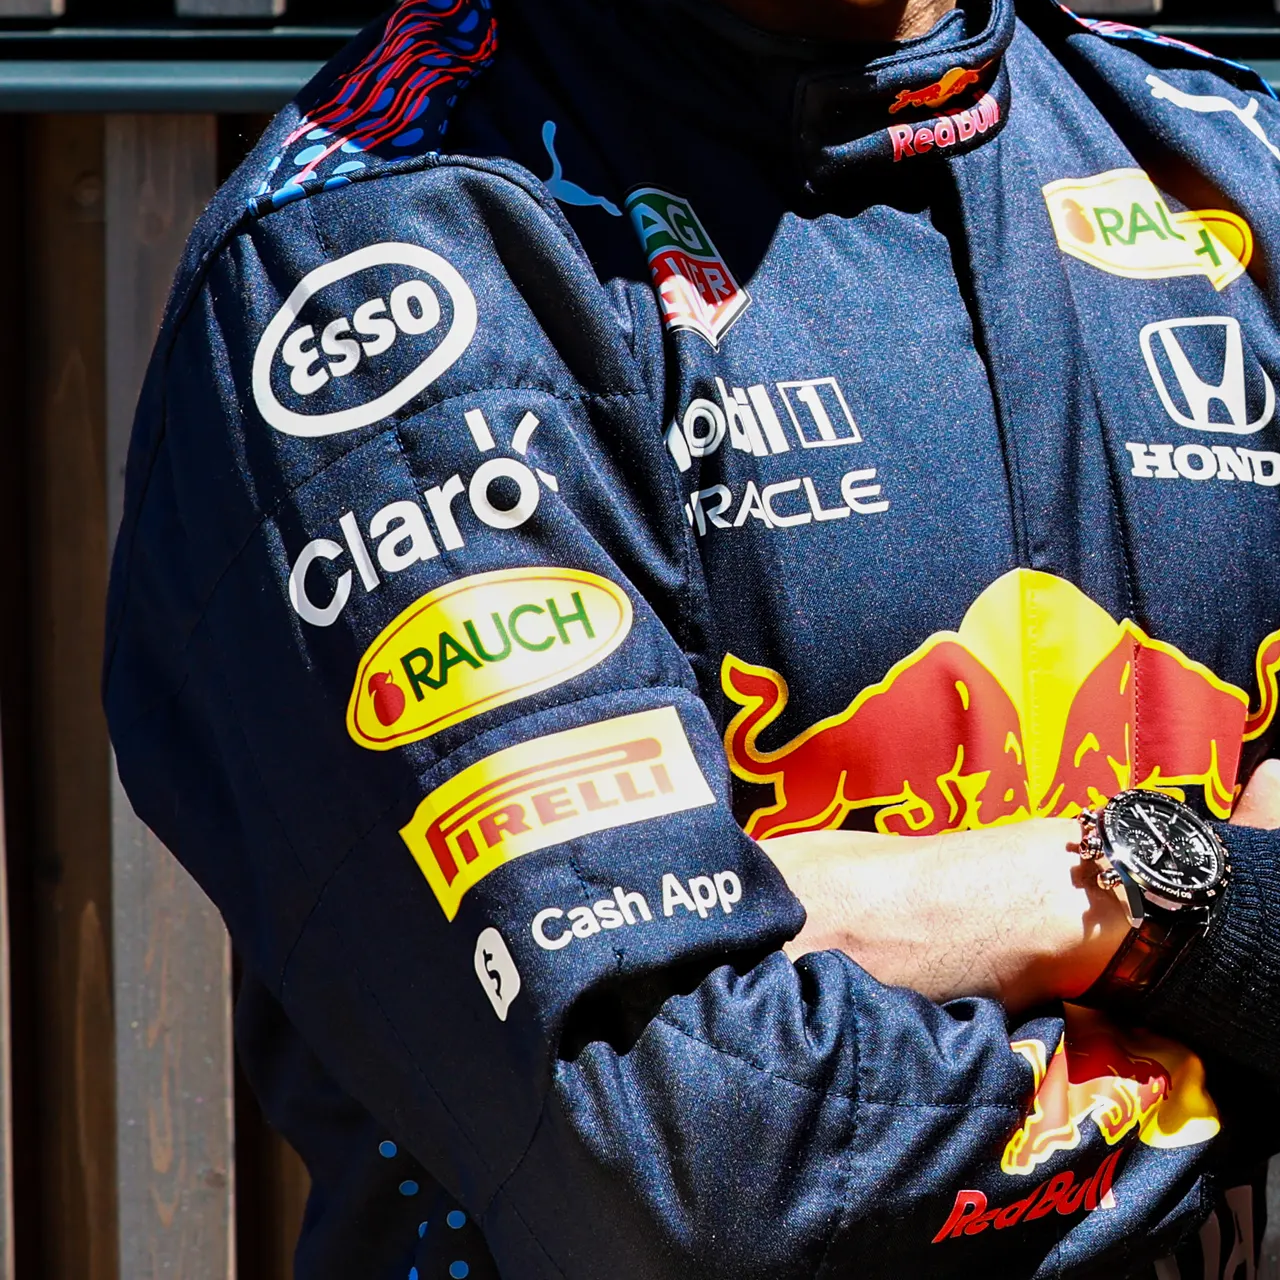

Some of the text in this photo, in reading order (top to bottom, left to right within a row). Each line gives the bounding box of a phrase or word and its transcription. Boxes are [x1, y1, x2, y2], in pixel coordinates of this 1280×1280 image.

[887, 90, 1000, 163] Red Bull
[289, 457, 540, 627] Claro
[685, 467, 890, 537] RACLE
[400, 591, 596, 702] RAUCH
[426, 736, 675, 887] PIRELLI
[531, 869, 743, 951] Cash App
[931, 1147, 1124, 1244] Red Bull
